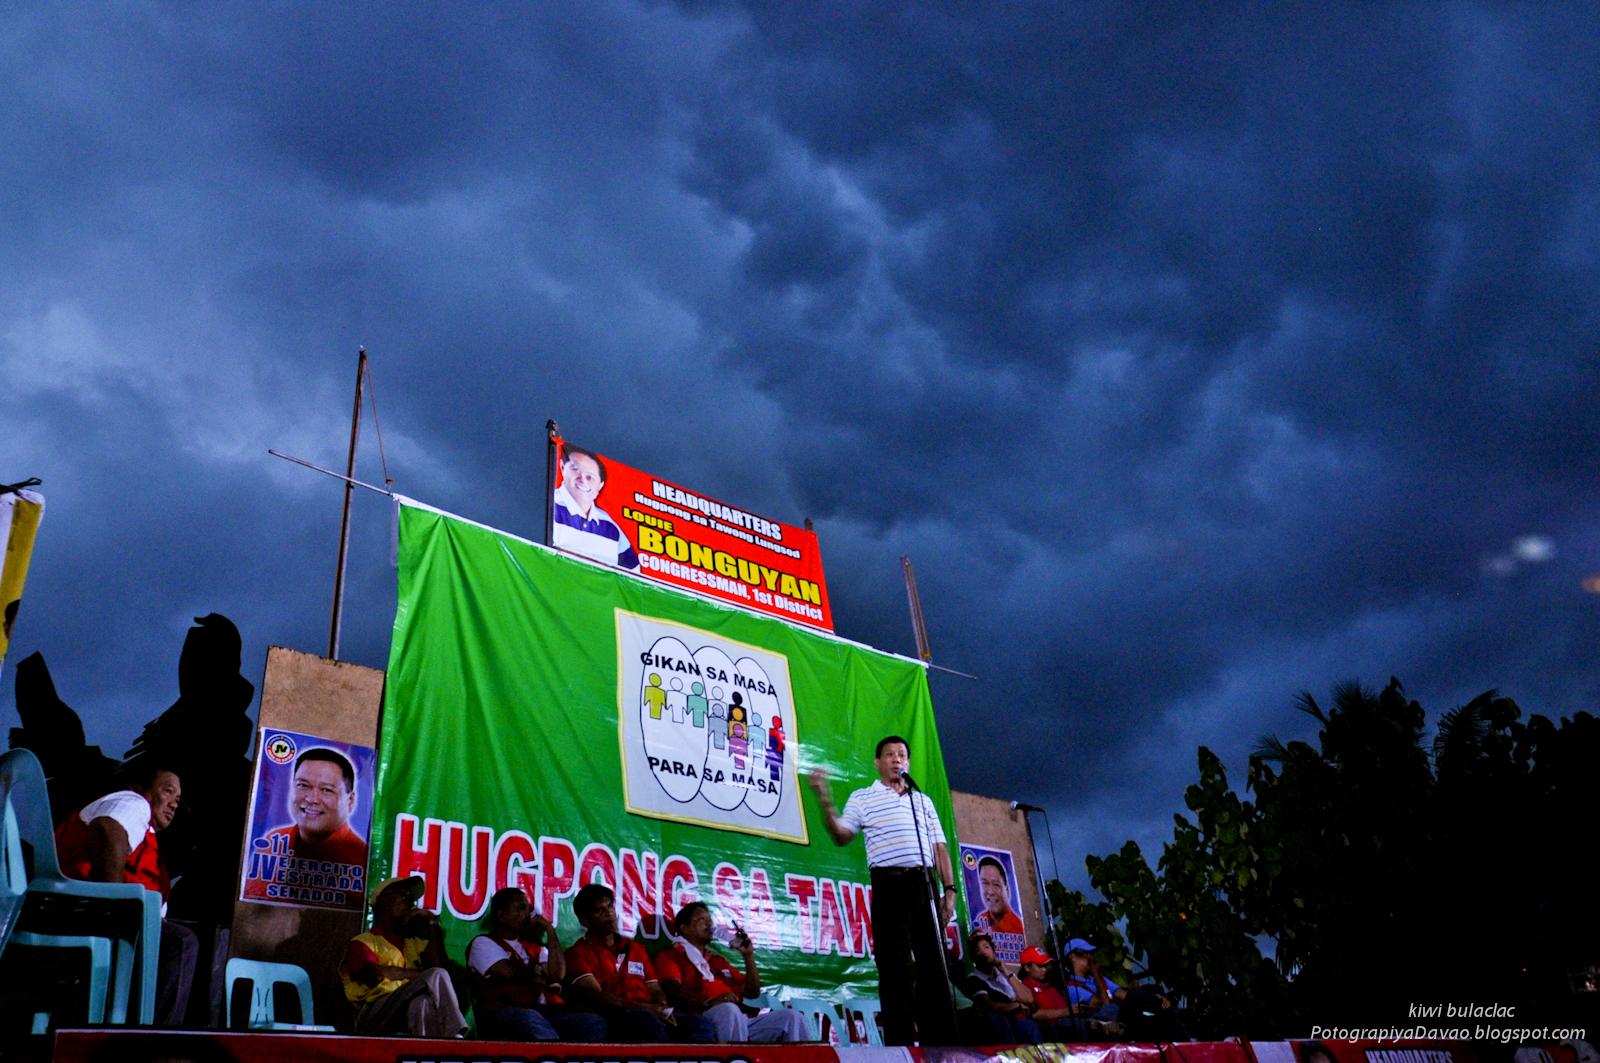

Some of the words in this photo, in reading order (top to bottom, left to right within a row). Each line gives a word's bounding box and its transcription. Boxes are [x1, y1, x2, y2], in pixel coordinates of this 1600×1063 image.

[623, 507, 674, 533] LOUIE
[634, 492, 691, 521] Hugpong
[692, 513, 708, 527] sa
[708, 518, 754, 544] Tawong
[754, 535, 801, 560] Lungsod
[652, 480, 782, 541] HEADQUARTERS
[638, 524, 822, 606] BONGUYAN
[638, 553, 751, 601] CONGRESSMAN,
[752, 588, 774, 607] 1st
[775, 596, 824, 622] District
[641, 652, 701, 677] GIKAN
[706, 666, 729, 684] SA
[734, 673, 778, 698] MASA
[649, 756, 698, 779] PARA
[703, 767, 725, 784] SA
[732, 772, 779, 796] MASA
[248, 852, 277, 882] JV
[278, 856, 363, 878] EJERCITO
[276, 869, 363, 892] ESTRADA
[393, 813, 699, 942] HUGPONG
[713, 861, 783, 951] SA
[267, 883, 346, 904] SENADOR
